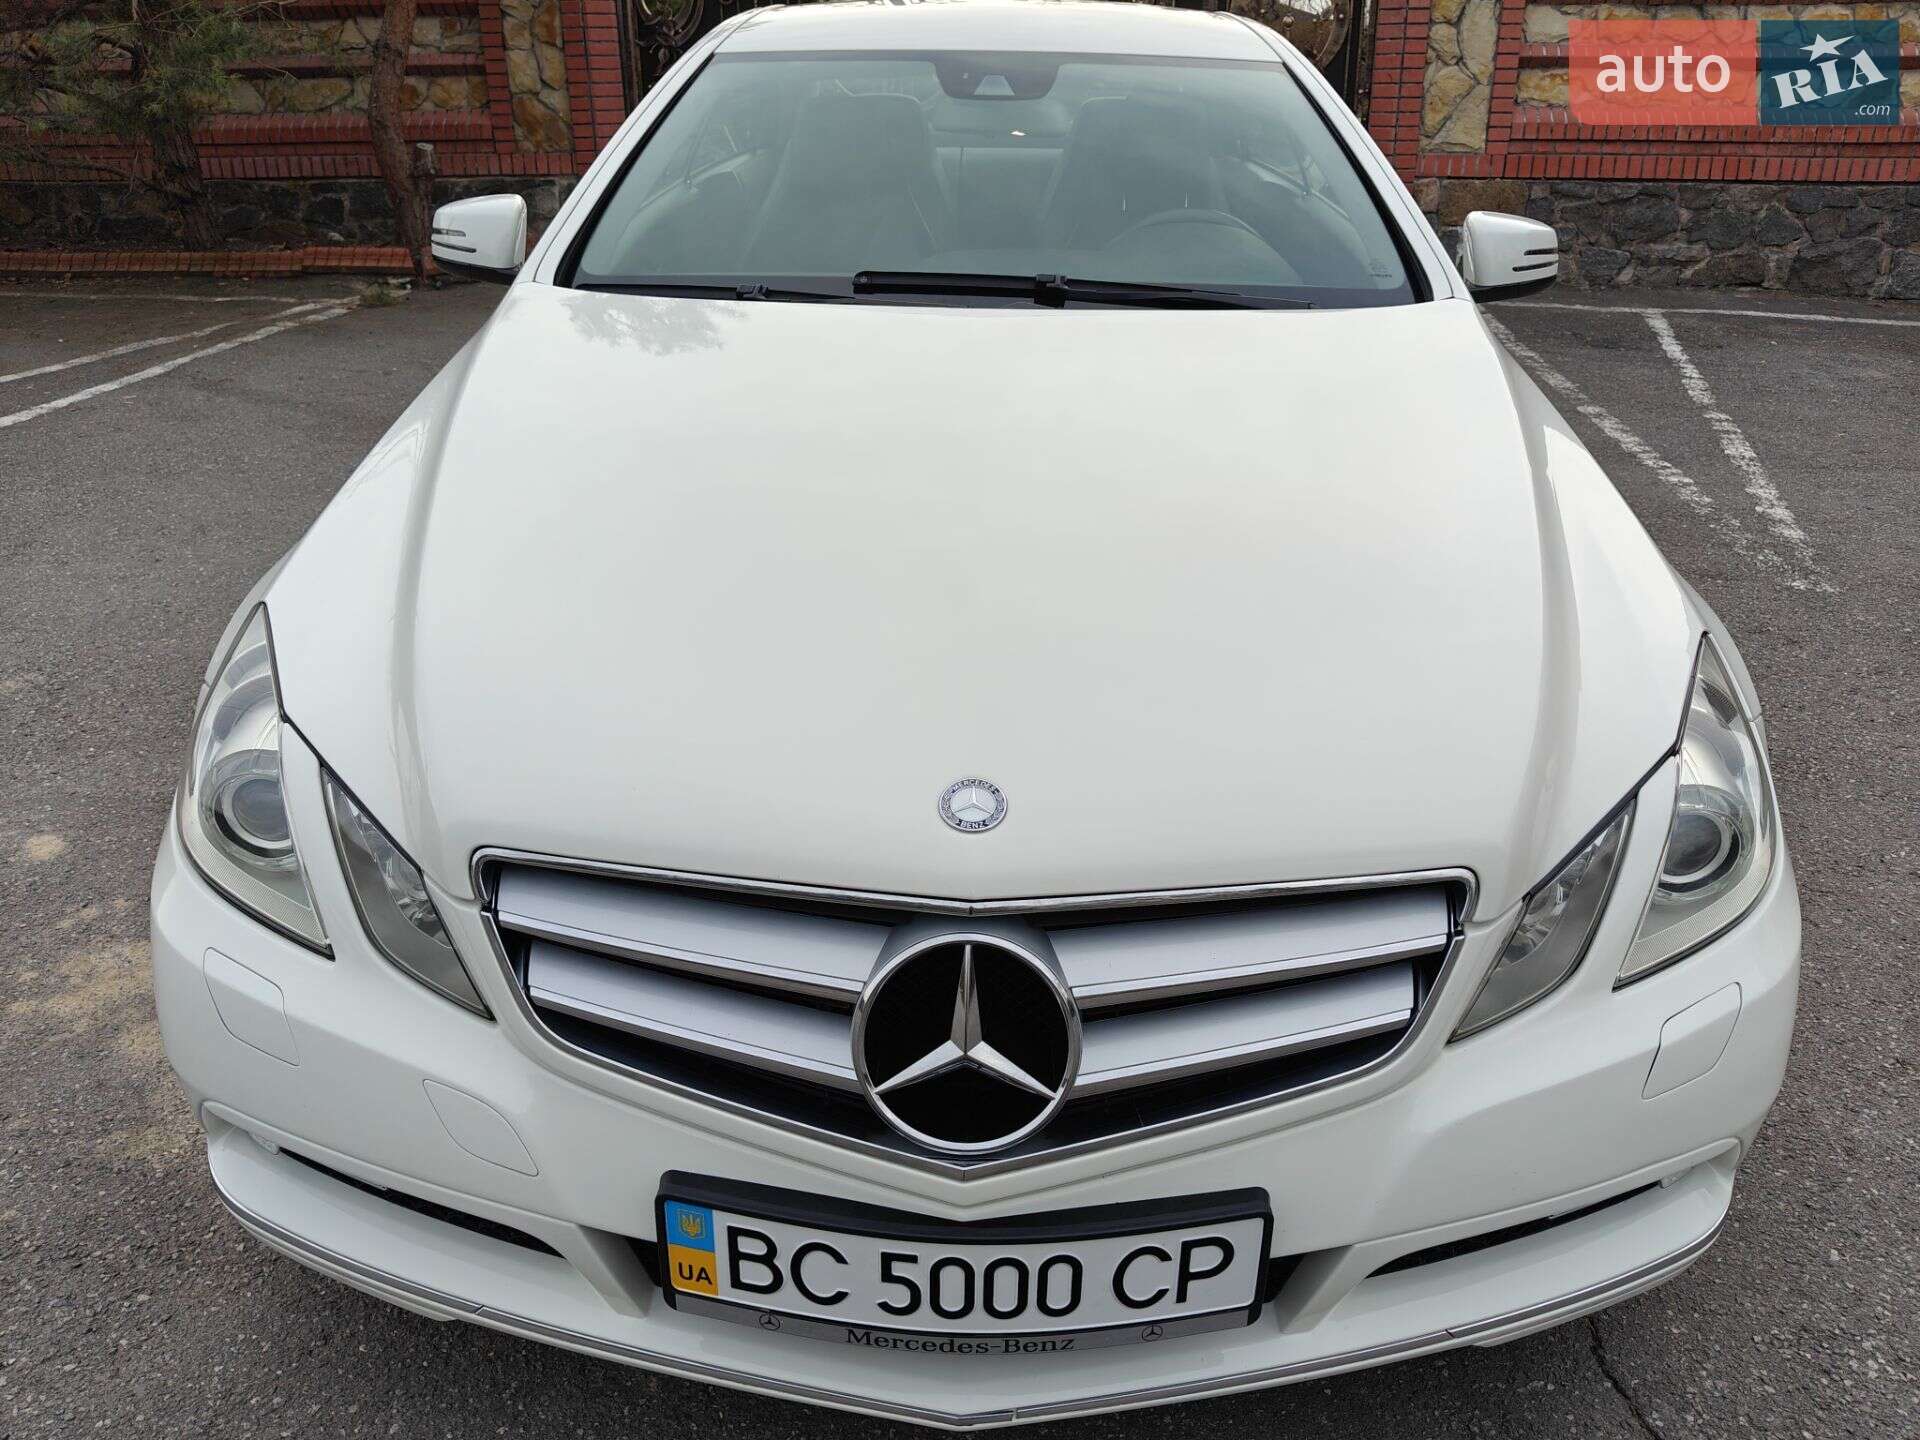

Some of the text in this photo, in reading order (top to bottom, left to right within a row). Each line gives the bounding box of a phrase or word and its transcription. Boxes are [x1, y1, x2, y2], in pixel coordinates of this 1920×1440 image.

[960, 820, 986, 829] BENZ
[678, 1260, 713, 1286] UA
[727, 1225, 1235, 1320] BC 5000 CP
[846, 1327, 1075, 1354] Mercedes-Benz
